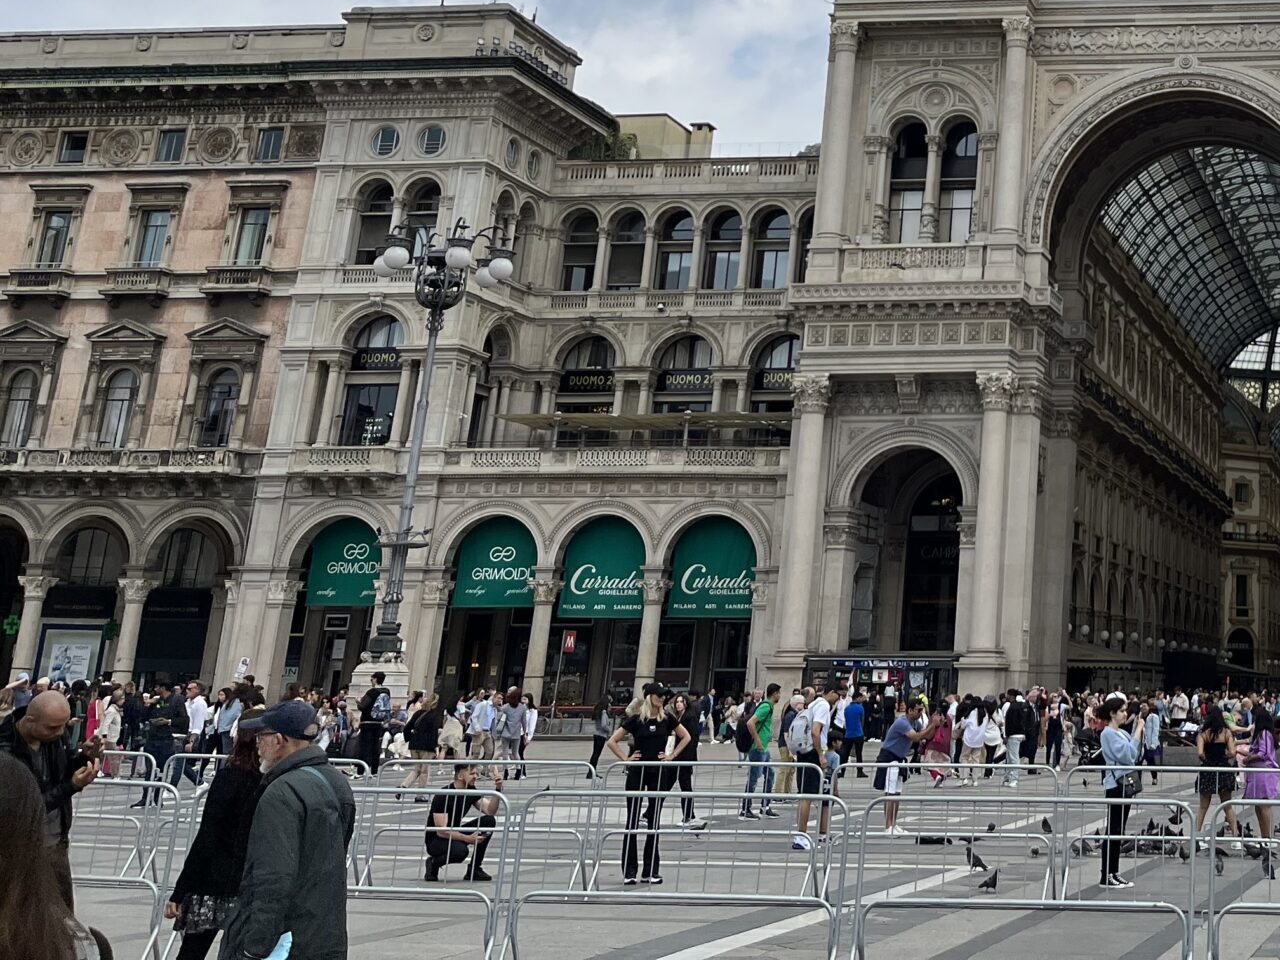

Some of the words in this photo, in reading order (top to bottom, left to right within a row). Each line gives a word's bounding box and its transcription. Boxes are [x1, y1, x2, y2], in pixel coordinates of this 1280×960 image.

[360, 353, 396, 363] DUOMO
[569, 375, 605, 385] DUOMO
[666, 374, 702, 384] DUOMO
[763, 373, 792, 383] DUOM
[570, 564, 643, 595] Currado
[681, 564, 752, 595] Currado
[564, 635, 575, 649] M
